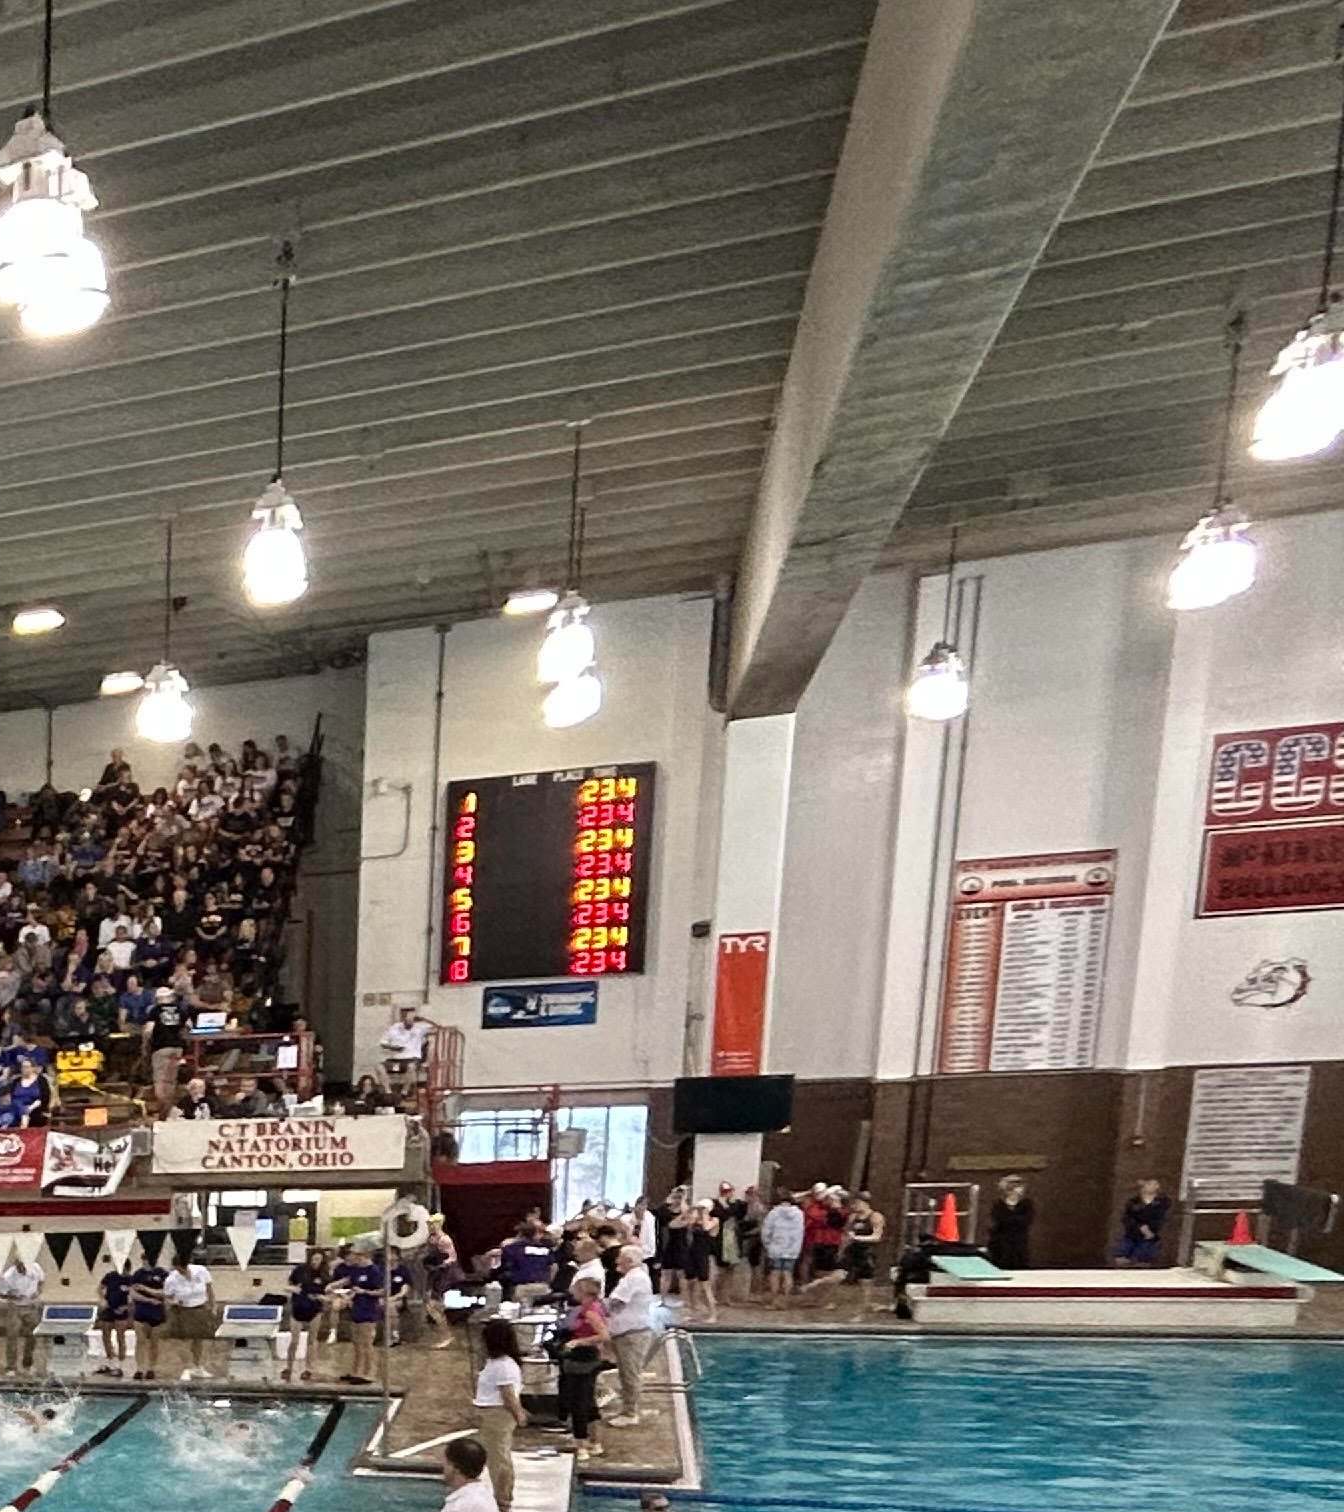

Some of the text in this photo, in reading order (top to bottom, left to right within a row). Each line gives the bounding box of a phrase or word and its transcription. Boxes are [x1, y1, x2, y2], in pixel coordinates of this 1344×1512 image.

[465, 792, 478, 813] 1
[456, 817, 475, 837] 2
[455, 840, 475, 863] 3
[454, 865, 473, 885] 4
[452, 888, 473, 910] 5
[451, 912, 471, 934] 6
[453, 936, 471, 956] 7
[720, 936, 766, 953] TYR
[450, 960, 469, 980] 8
[256, 1120, 335, 1136] BRANIN
[208, 1136, 348, 1153] NATATORIUM
[201, 1152, 354, 1170] CANTON, OHIO
